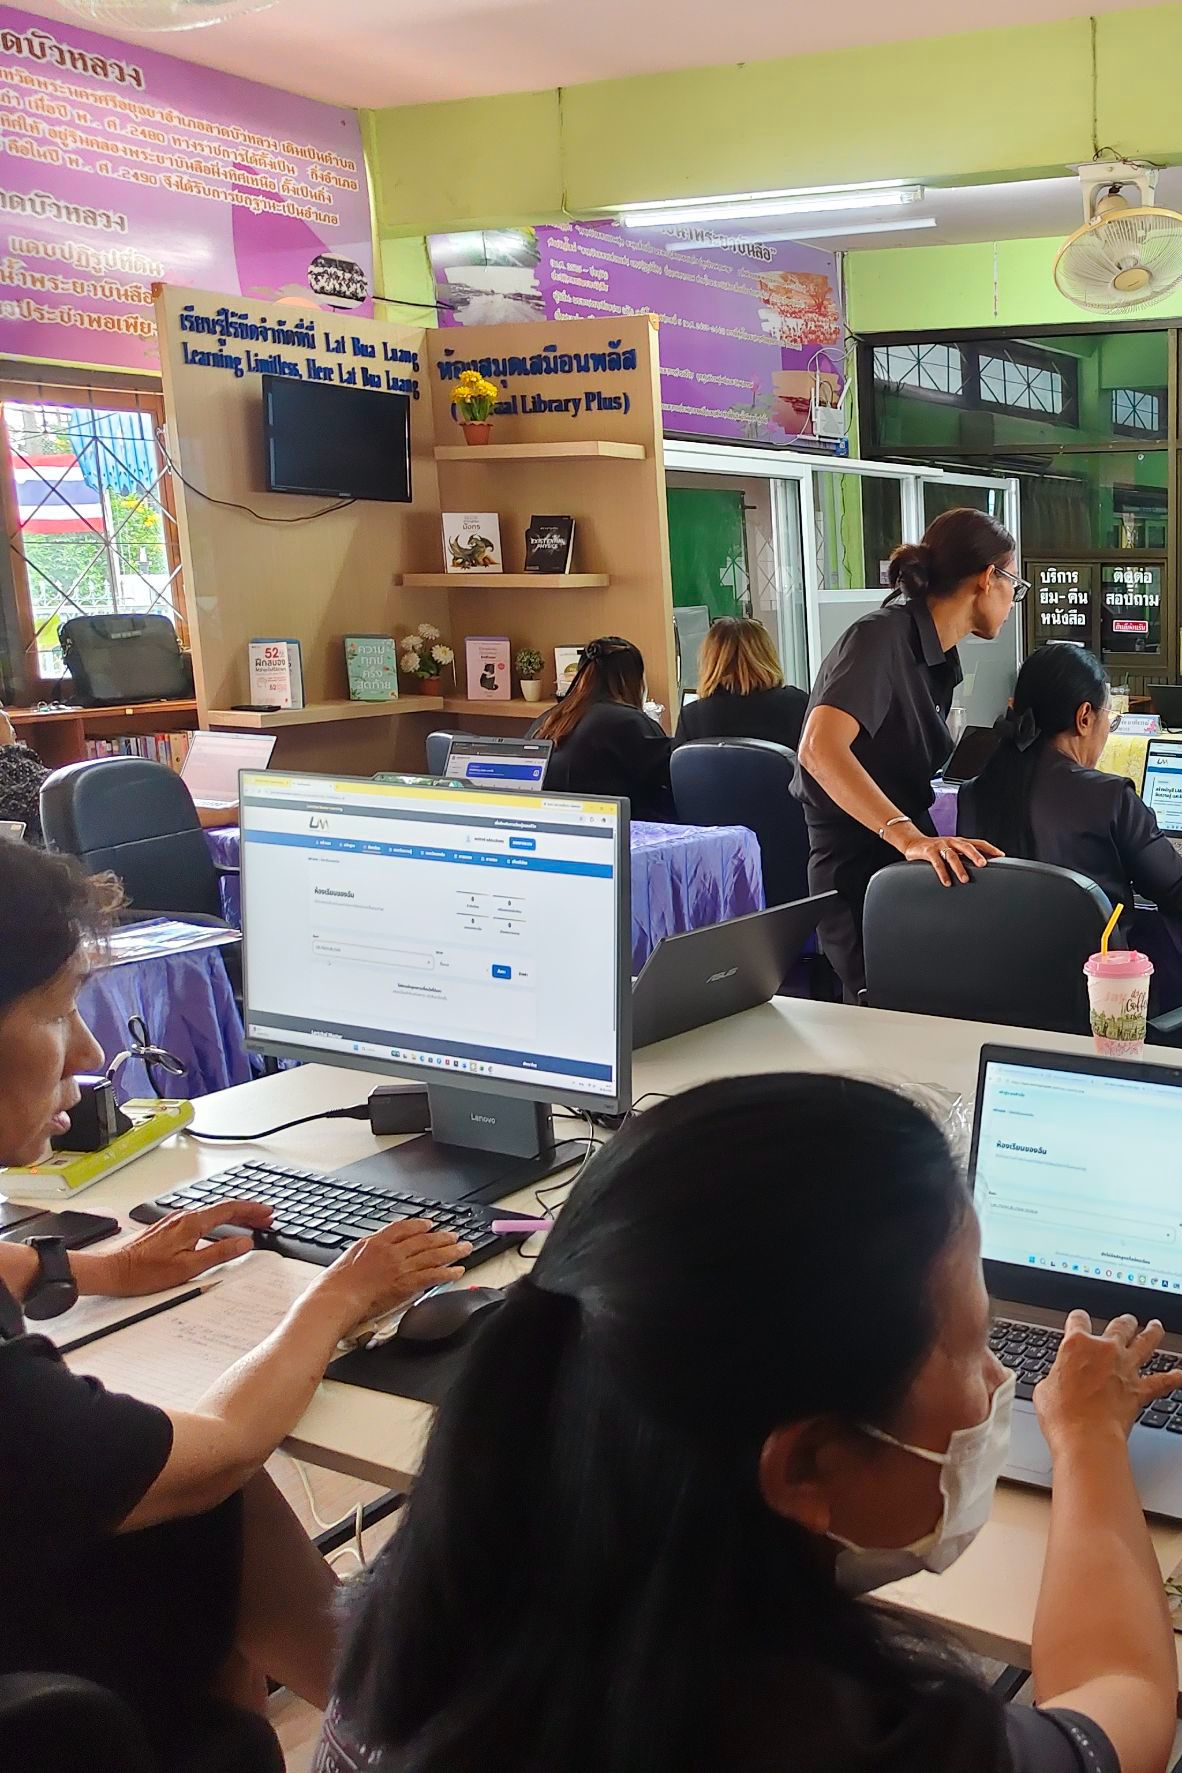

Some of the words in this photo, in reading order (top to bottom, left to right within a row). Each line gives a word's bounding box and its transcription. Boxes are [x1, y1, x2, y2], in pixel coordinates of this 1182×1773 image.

[324, 332, 347, 354] Lat
[350, 336, 376, 358] Bua
[382, 341, 419, 372] Luang
[181, 341, 244, 378] Learning
[305, 358, 334, 381] Here
[337, 363, 357, 385] Lat
[361, 367, 382, 388] Bua
[385, 370, 420, 400] Luang
[520, 393, 582, 417] Library
[1040, 568, 1079, 584] บริการ
[1113, 567, 1153, 584] ติดต่อ
[1105, 593, 1160, 607] สอบถาม
[1040, 608, 1086, 626] หนังสือ
[264, 647, 280, 658] 52
[359, 645, 385, 654] ความ
[706, 967, 738, 984] ASUS
[470, 1112, 496, 1125] Lenovo
